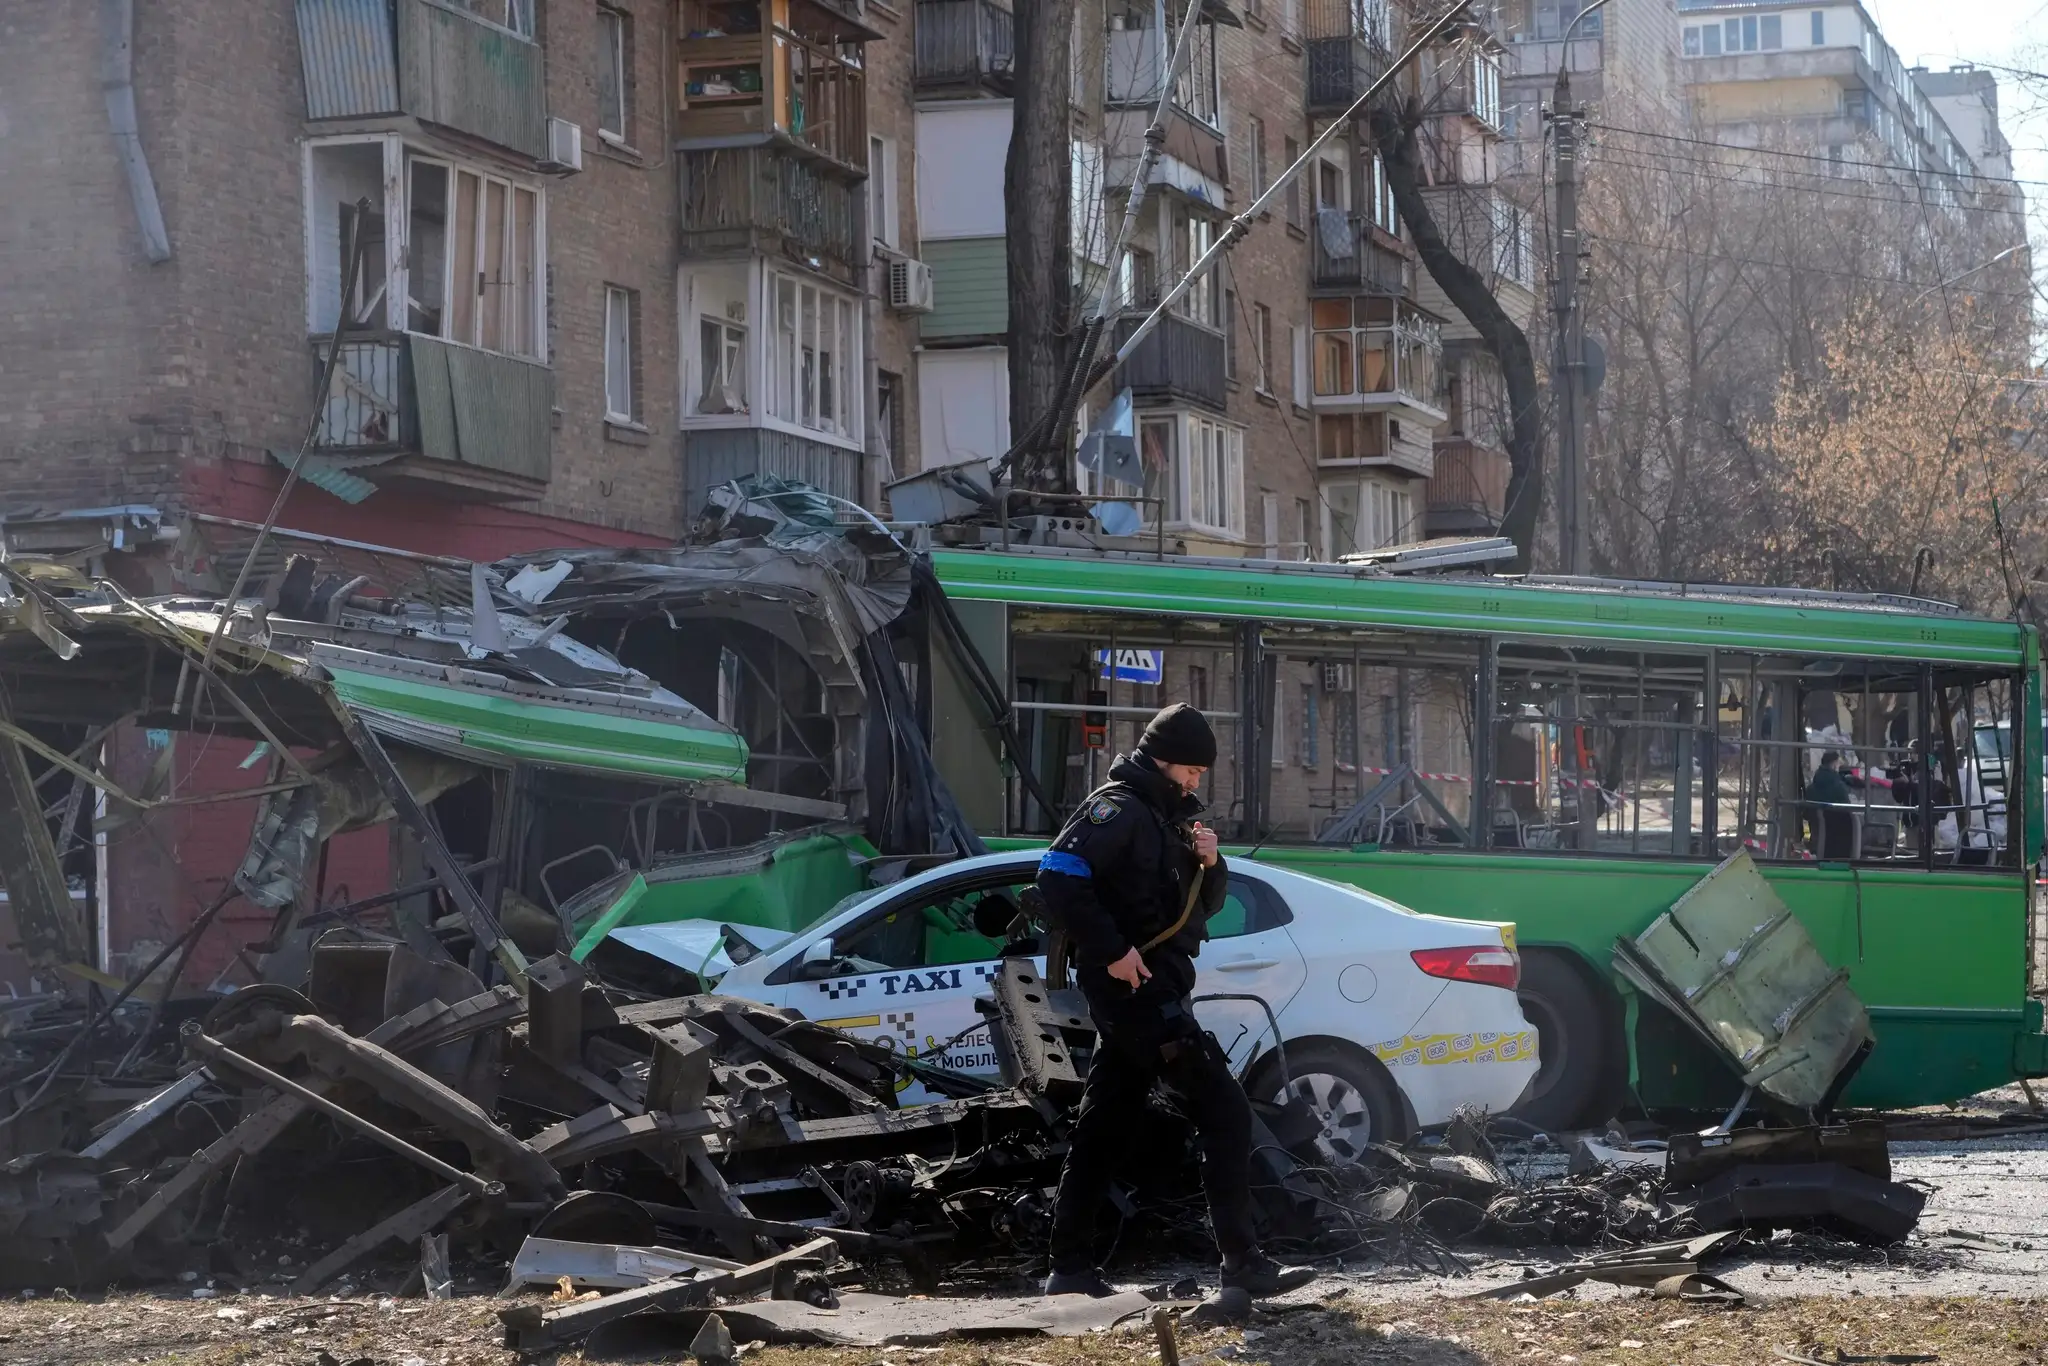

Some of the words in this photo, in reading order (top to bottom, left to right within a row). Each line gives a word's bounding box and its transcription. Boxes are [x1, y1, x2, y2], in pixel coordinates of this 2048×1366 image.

[879, 969, 963, 995] TAXI
[1455, 1038, 1471, 1049] 808
[1429, 1045, 1445, 1056] 808
[1503, 1044, 1516, 1055] 808
[1404, 1052, 1418, 1063] 808
